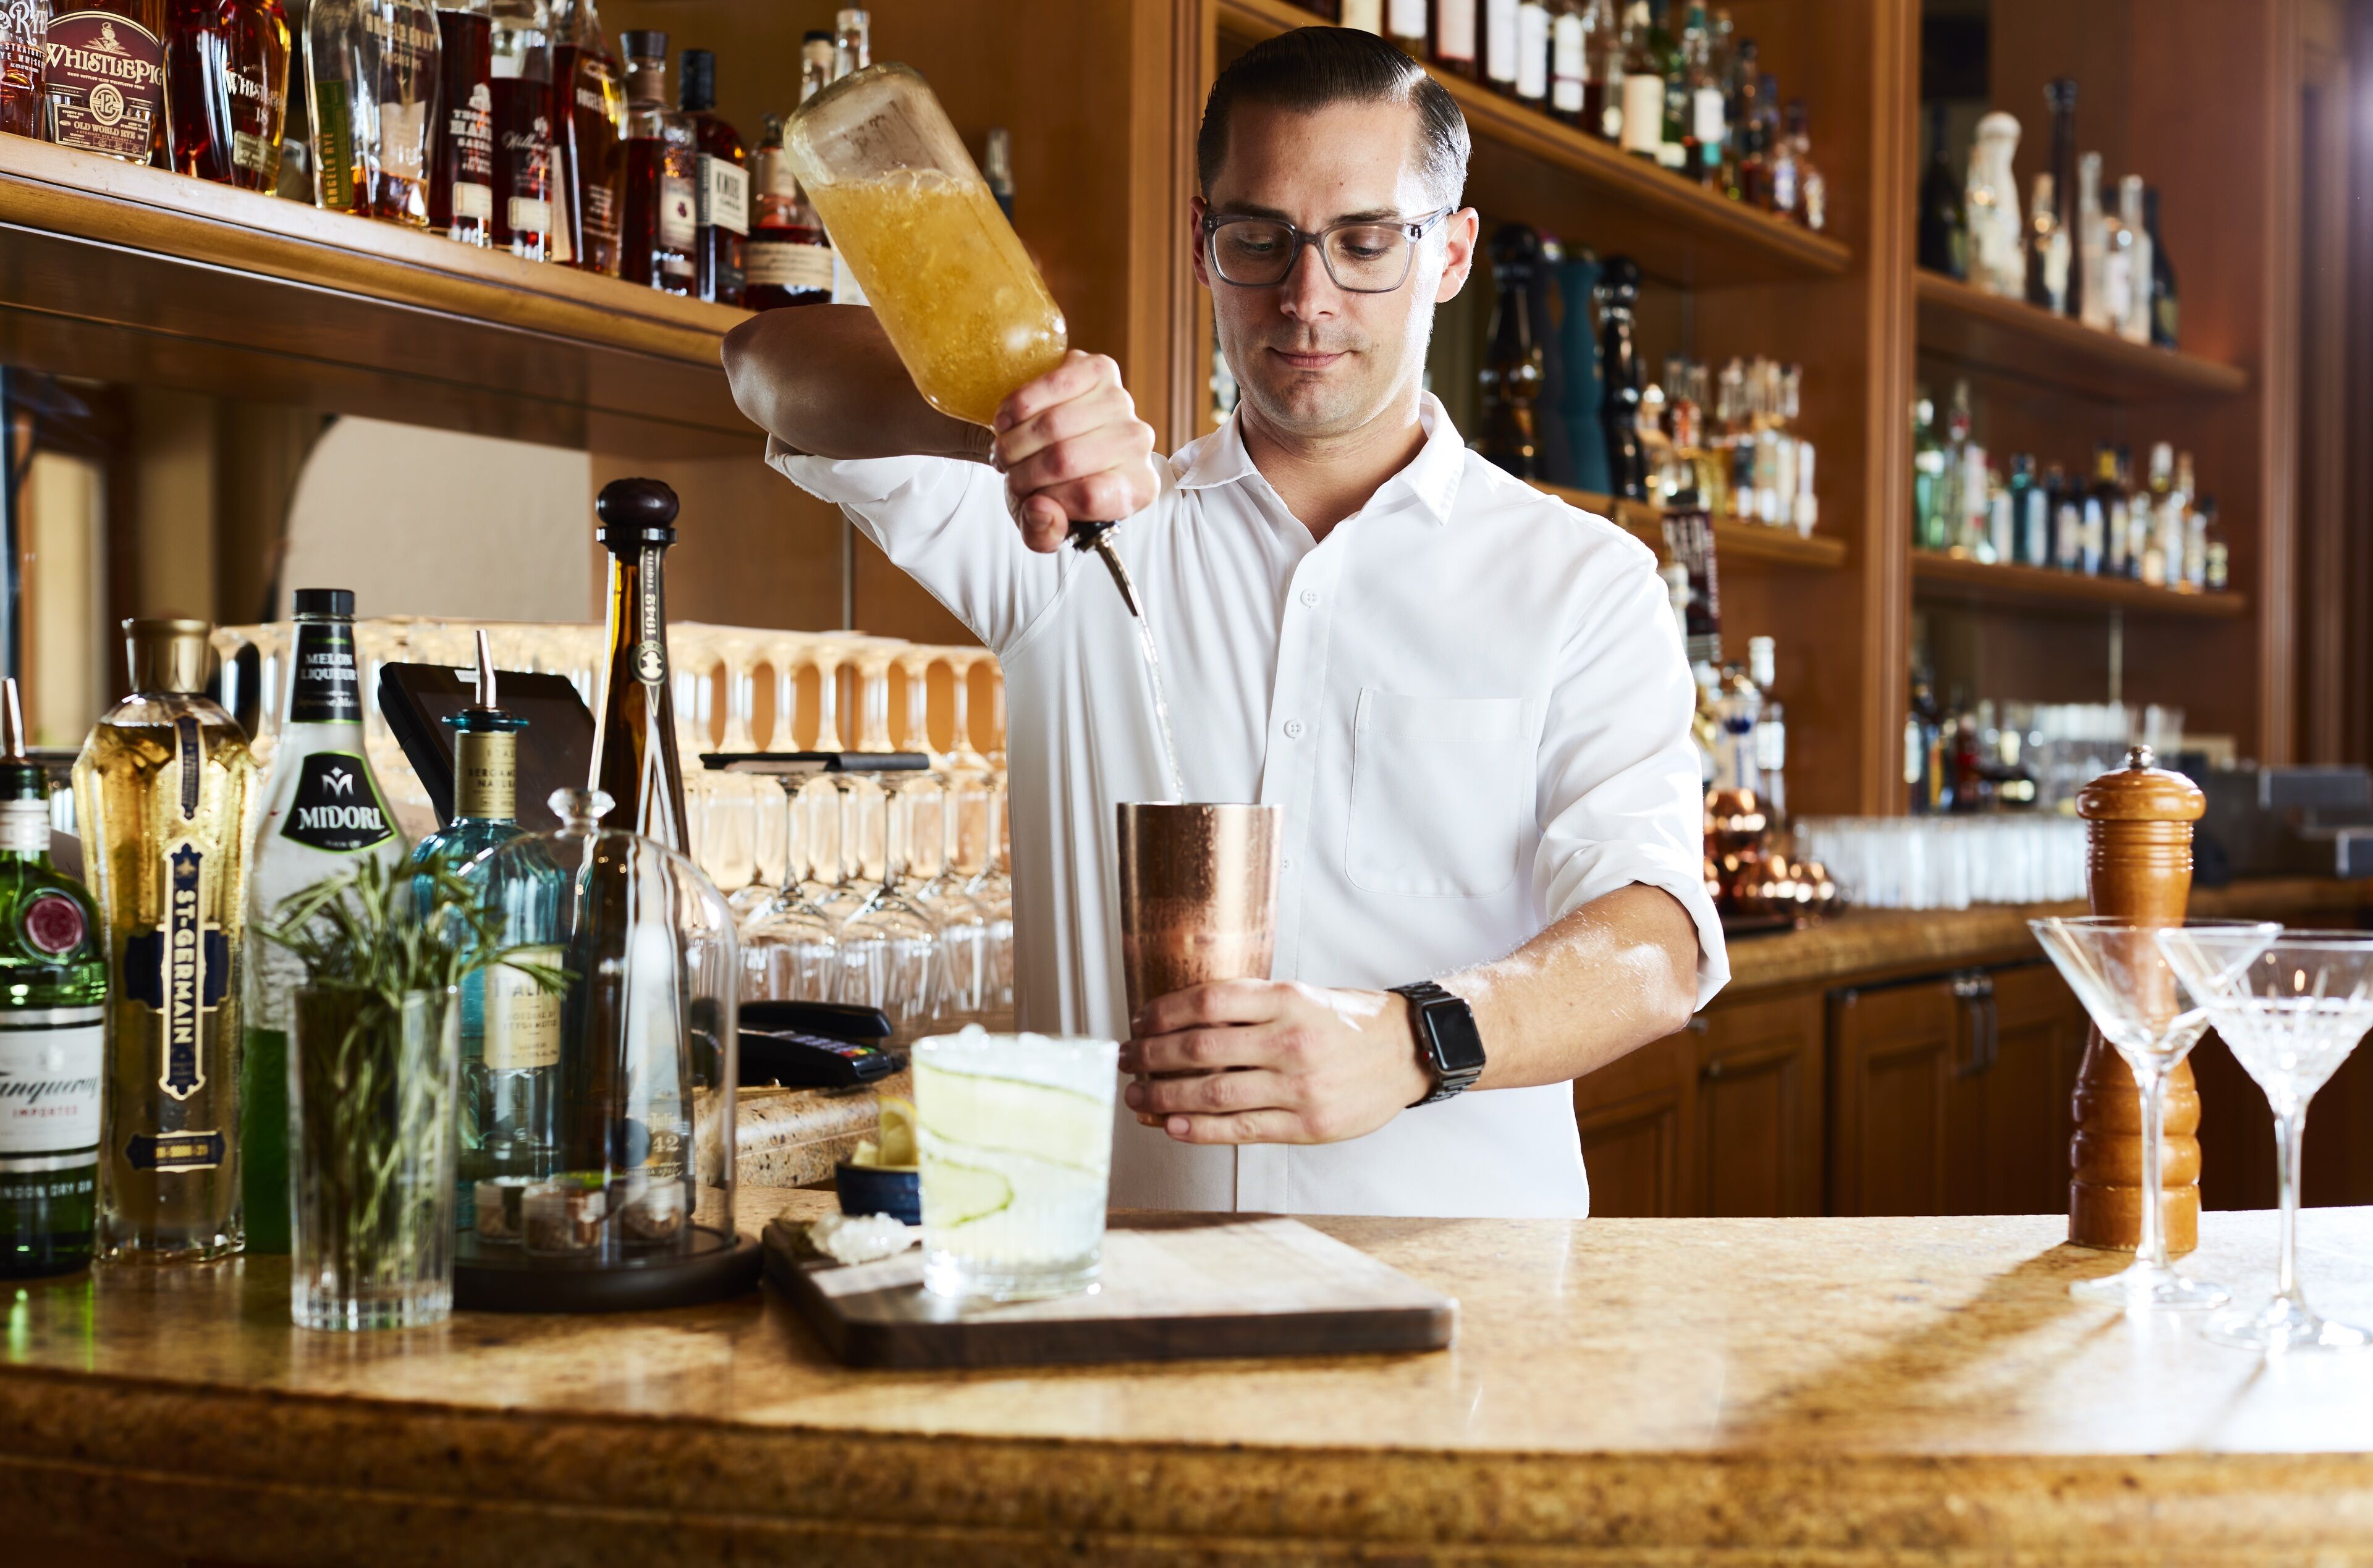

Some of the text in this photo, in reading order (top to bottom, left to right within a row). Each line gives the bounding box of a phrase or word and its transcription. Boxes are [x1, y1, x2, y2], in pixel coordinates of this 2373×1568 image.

[9, 1, 48, 46] RYE
[0, 51, 12, 60] YE
[5, 42, 42, 57] STRAIGHT
[45, 43, 163, 85] WHISTLEPIG
[100, 93, 115, 114] 12
[256, 106, 269, 125] 18
[74, 120, 91, 130] OLD
[91, 124, 119, 136] WORLD
[121, 129, 136, 140] RYE
[322, 132, 335, 154] RYE
[325, 157, 339, 205] ANGELS
[646, 550, 654, 589] TEQUILA
[645, 593, 656, 636] 1942
[305, 652, 353, 666] MELON
[300, 667, 358, 681] LIQUEUR
[297, 805, 386, 831] MIDORI
[173, 889, 197, 1044] ST-GERMAIN
[0, 1071, 98, 1106] anqueray
[12, 1105, 78, 1118] IMPORTED
[652, 1134, 680, 1153] 42
[2, 1179, 93, 1199] NDON DRY GIN
